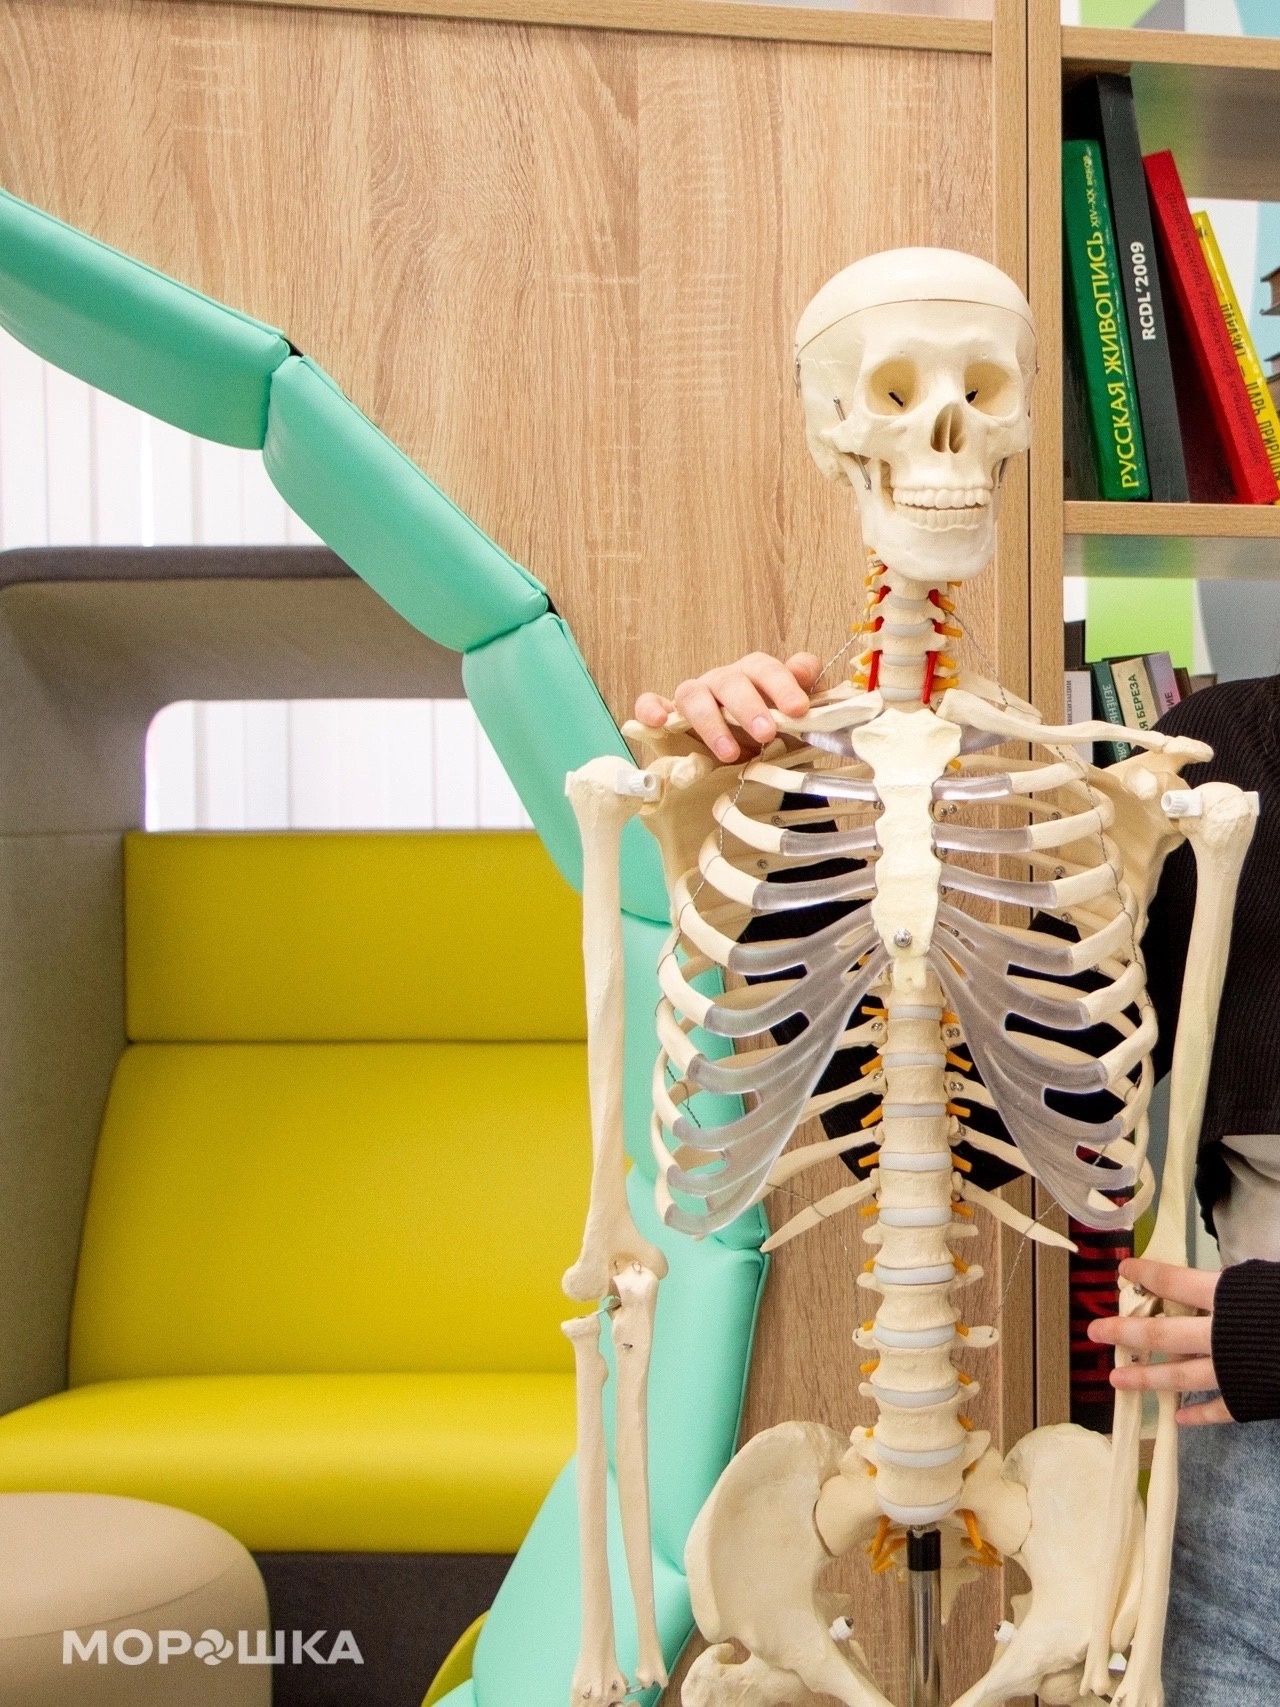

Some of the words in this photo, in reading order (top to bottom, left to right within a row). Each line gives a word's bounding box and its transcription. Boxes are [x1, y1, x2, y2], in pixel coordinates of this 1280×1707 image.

[1088, 230, 1121, 376] ЖИВОПИСЬ
[1130, 240, 1157, 341] RCDL'2009
[1246, 381, 1268, 423] ЦАРЬ
[1107, 384, 1140, 489] РУССКАЯ
[1102, 684, 1120, 725] ЗЕЛЁНЫ
[1128, 673, 1146, 719] БЕРЕЗА
[1164, 691, 1175, 709] ИЕ
